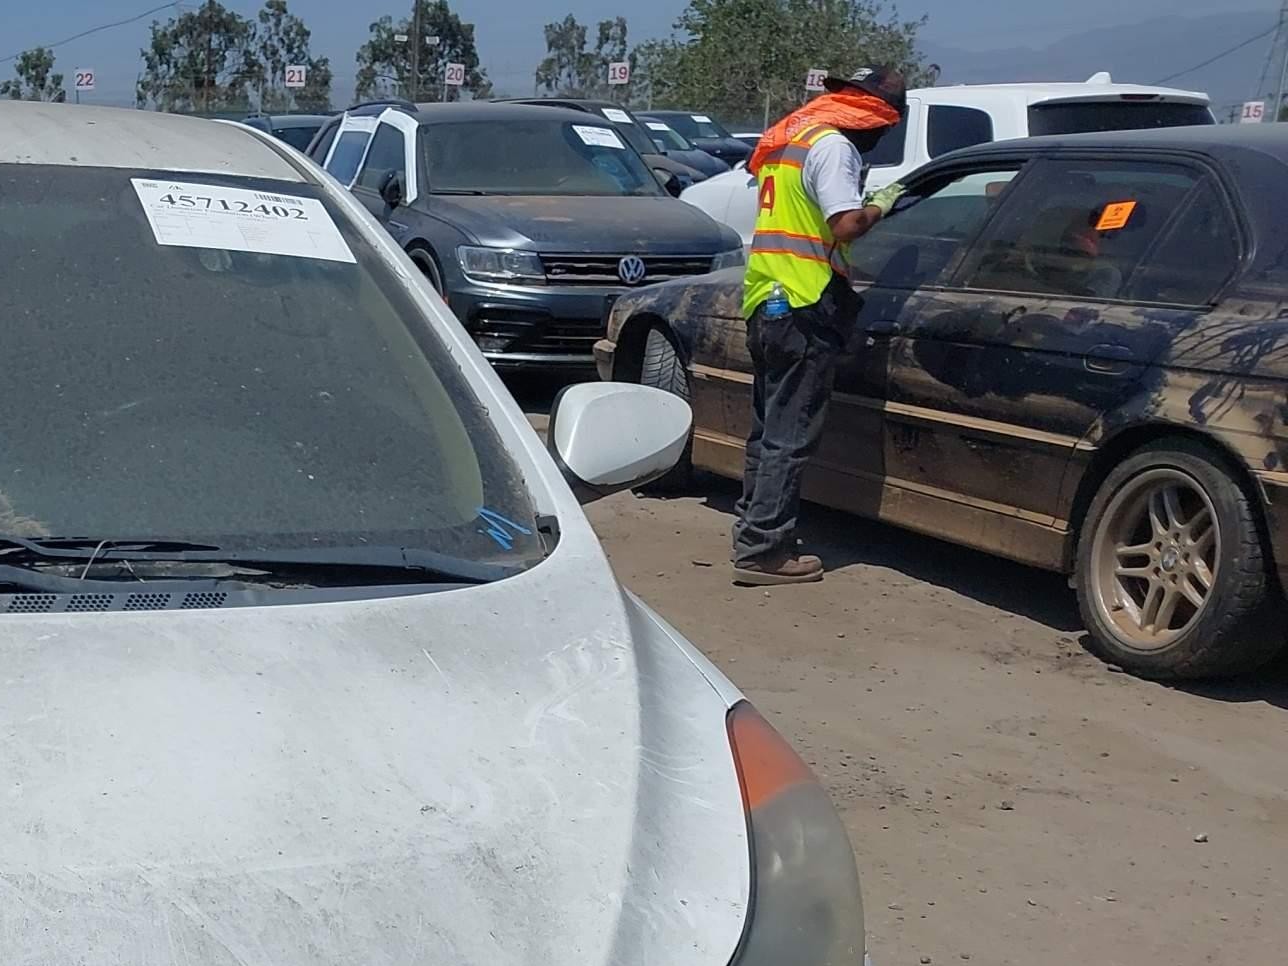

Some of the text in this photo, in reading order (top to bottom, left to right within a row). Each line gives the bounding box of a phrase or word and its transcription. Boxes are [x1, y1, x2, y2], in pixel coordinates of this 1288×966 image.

[76, 73, 93, 87] 22
[287, 70, 304, 83] 21
[447, 67, 463, 82] 20
[610, 66, 628, 80] 19
[808, 74, 826, 87] 18
[1243, 105, 1262, 119] 15
[159, 193, 308, 221] 45712402
